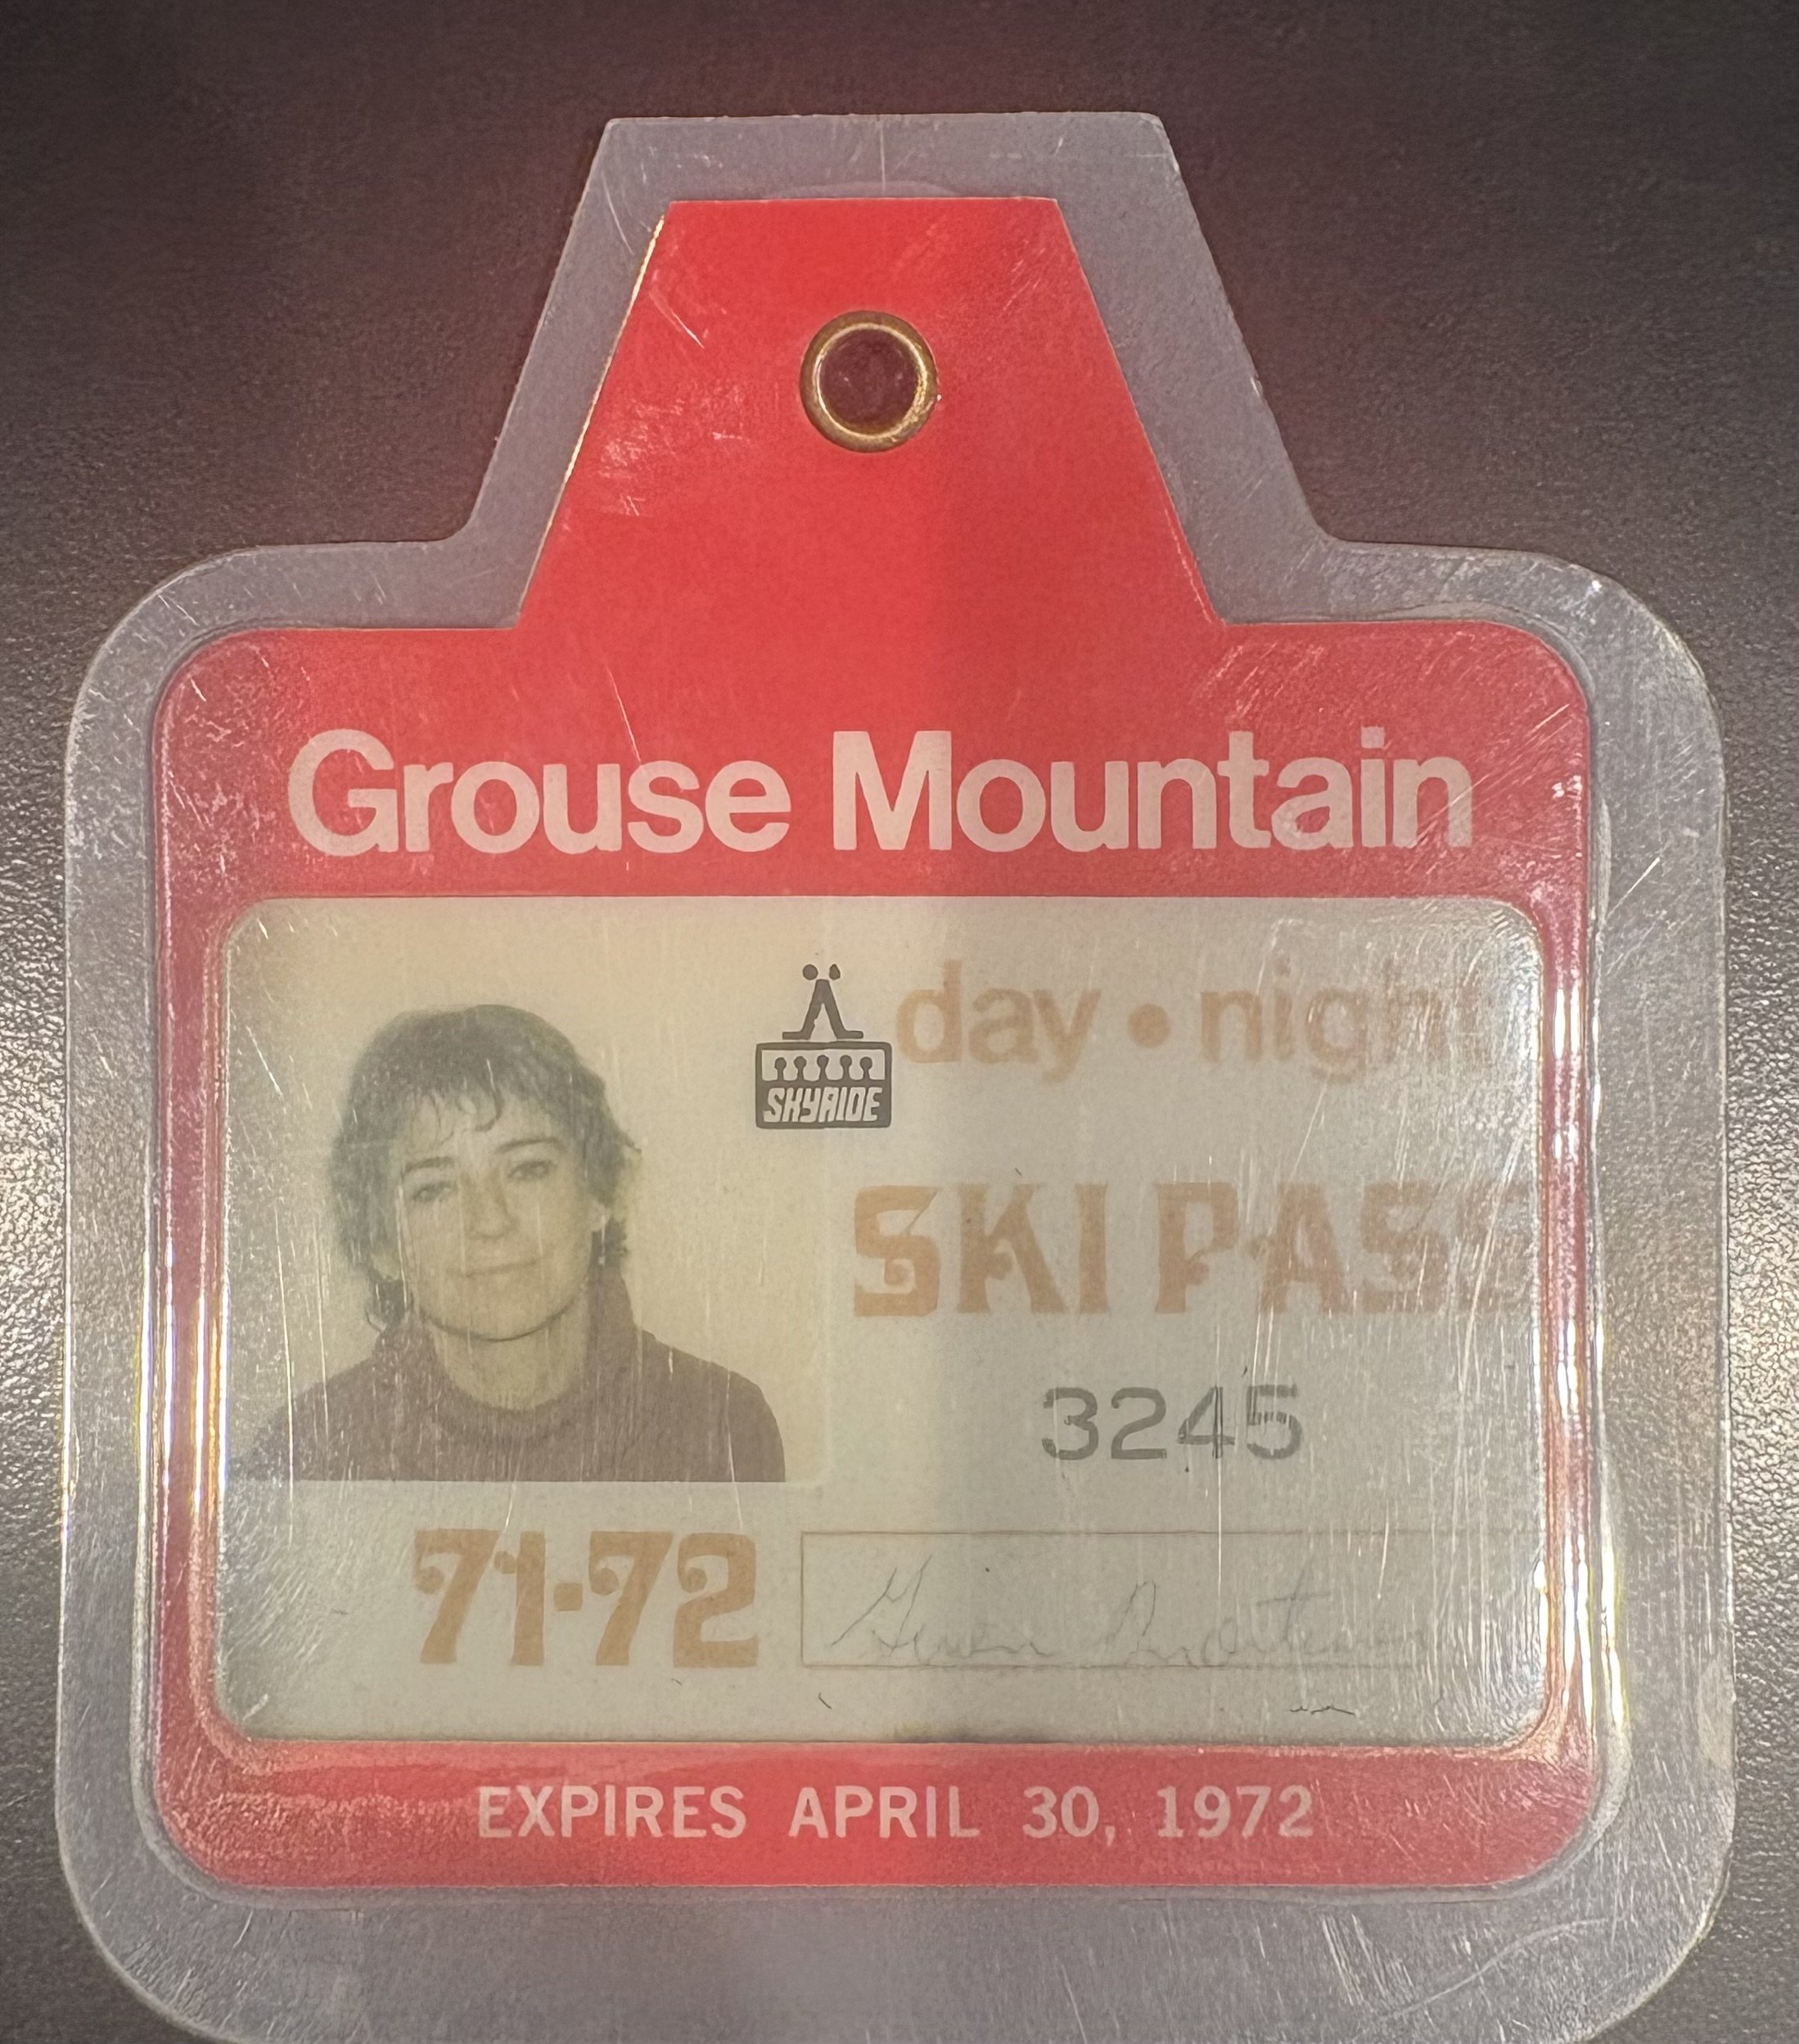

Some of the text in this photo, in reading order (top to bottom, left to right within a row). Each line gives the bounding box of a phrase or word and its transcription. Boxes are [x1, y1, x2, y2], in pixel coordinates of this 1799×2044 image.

[288, 727, 1472, 856] Grouse Mountain
[895, 960, 1101, 1086] day
[762, 1087, 882, 1123] SKYRIDE
[854, 1182, 1111, 1317] SKI
[1042, 1384, 1303, 1460] 3245
[414, 1528, 759, 1668] 71-72
[478, 1785, 1314, 1847] EXPIRES APRIL 30, 1972
